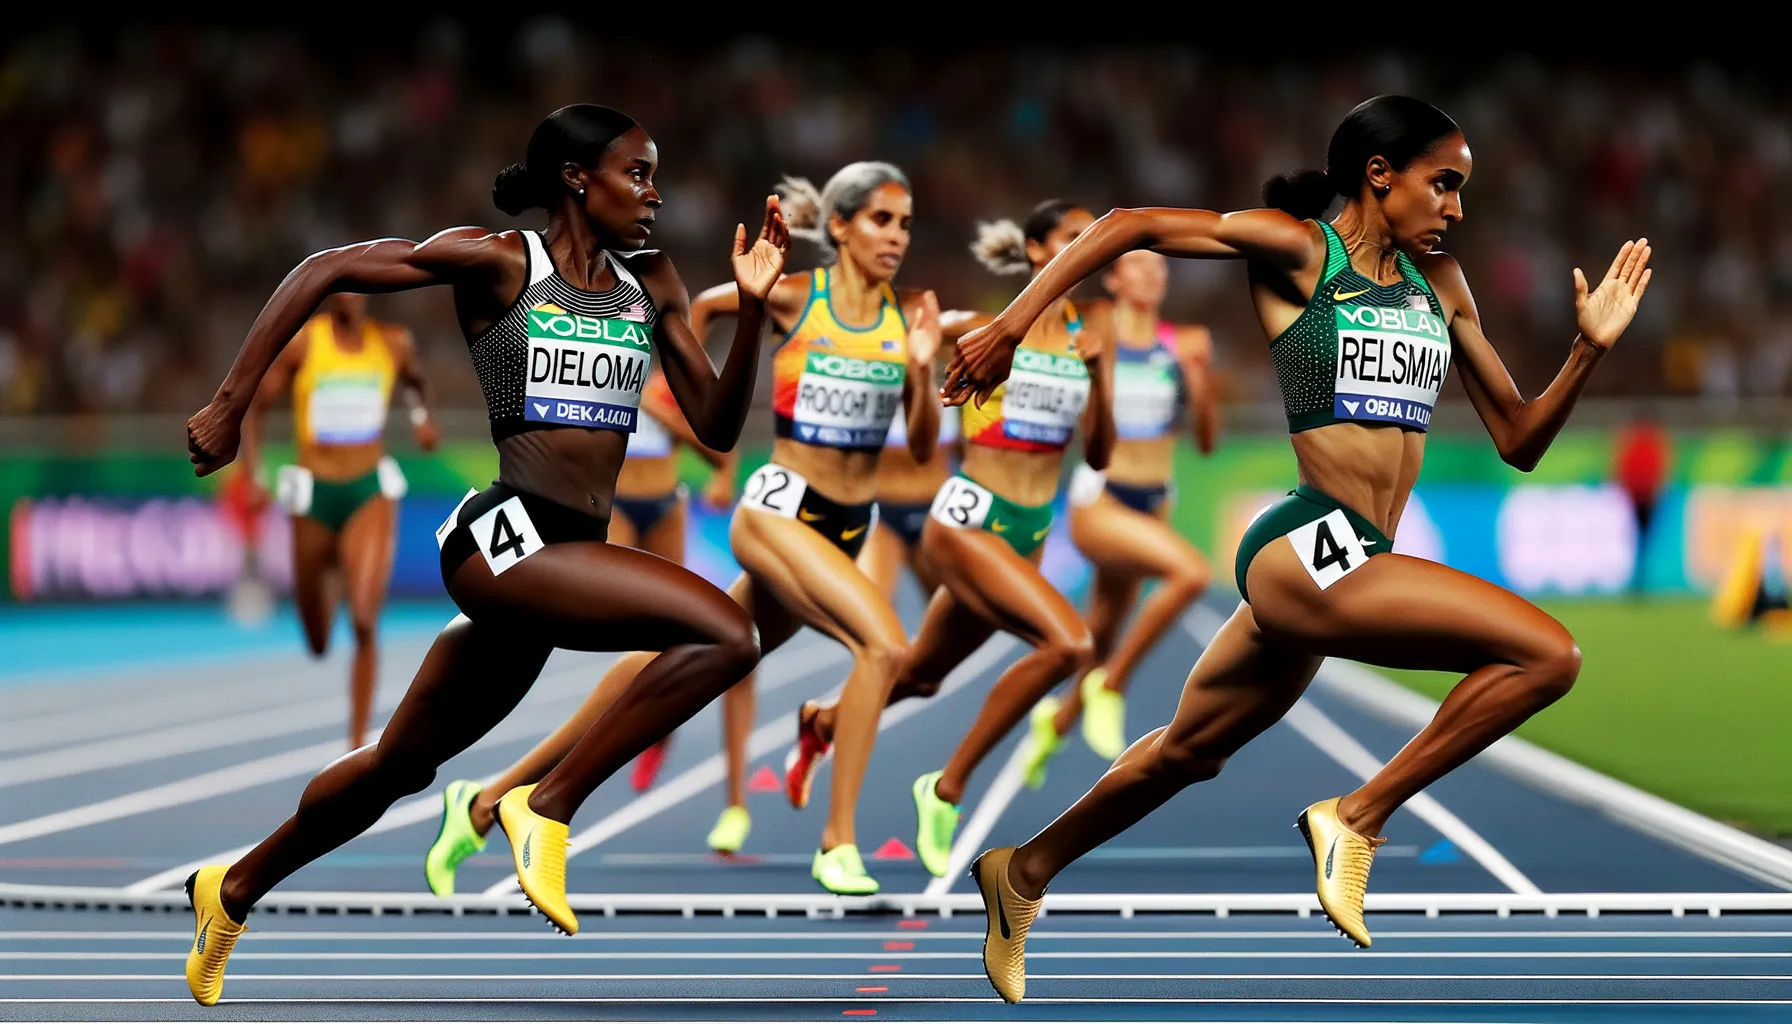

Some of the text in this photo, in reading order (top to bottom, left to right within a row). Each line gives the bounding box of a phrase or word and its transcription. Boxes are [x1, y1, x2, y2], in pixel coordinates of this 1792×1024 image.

[530, 347, 645, 395] DIELOMA
[489, 508, 525, 559] 4
[1313, 520, 1351, 572] 4
